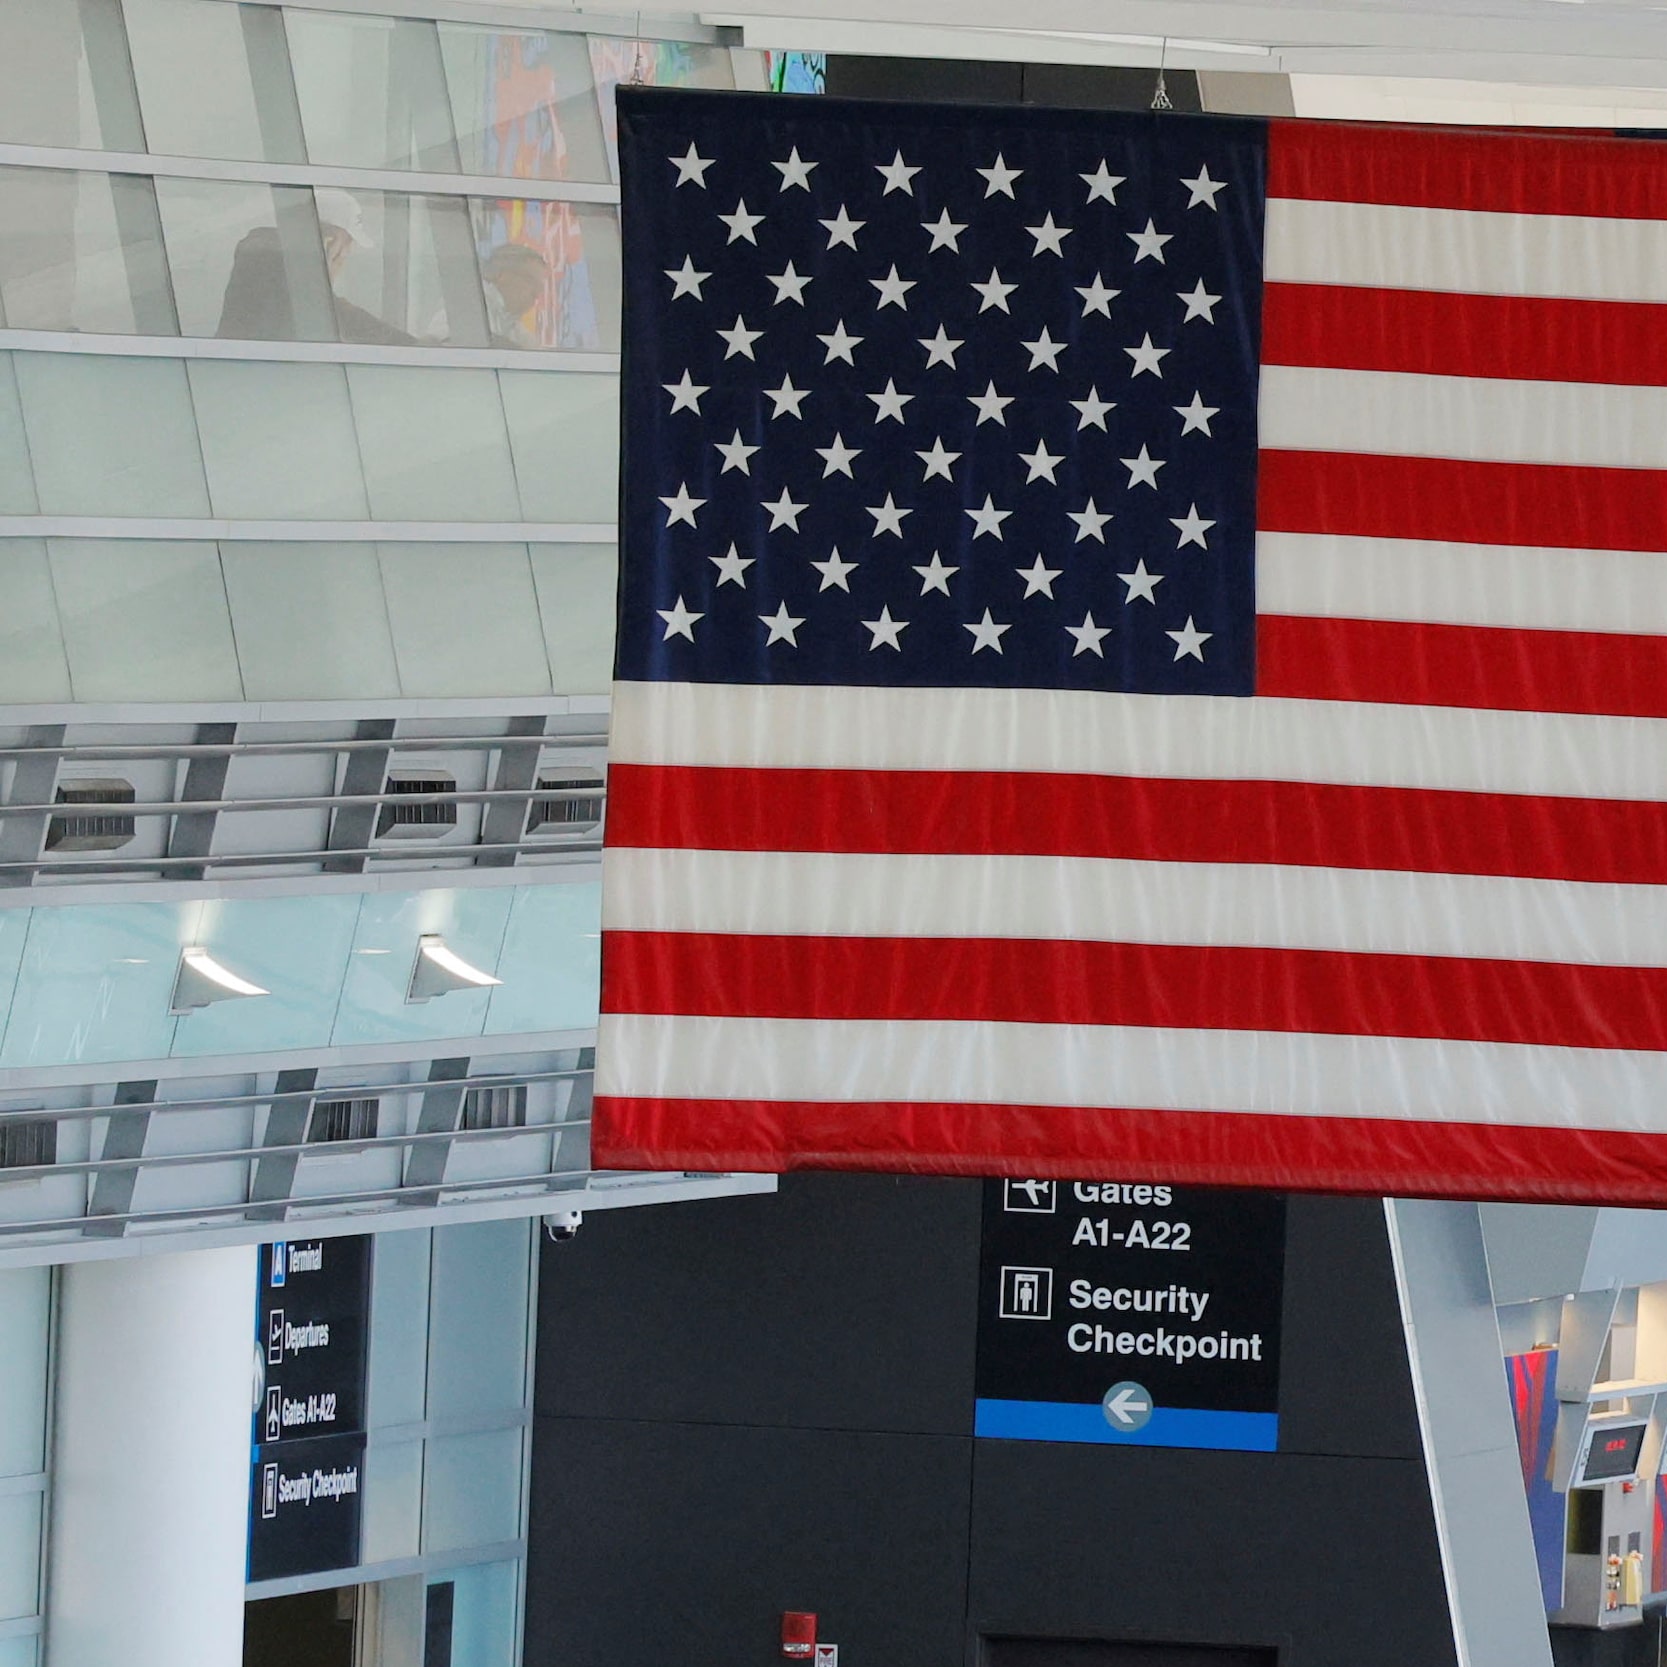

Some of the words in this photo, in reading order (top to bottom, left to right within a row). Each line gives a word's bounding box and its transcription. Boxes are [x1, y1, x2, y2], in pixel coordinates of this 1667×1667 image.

[1073, 1183, 1173, 1207] Gates
[1072, 1217, 1191, 1251] A1-A22
[288, 1242, 323, 1273] Terminal
[1068, 1279, 1210, 1322] Security
[285, 1320, 329, 1356] Departures
[1066, 1323, 1263, 1365] Checkpoint
[282, 1397, 306, 1427] Gates
[306, 1392, 336, 1423] A1-A22
[278, 1472, 311, 1506] Security
[312, 1466, 357, 1502] Checkpoint
